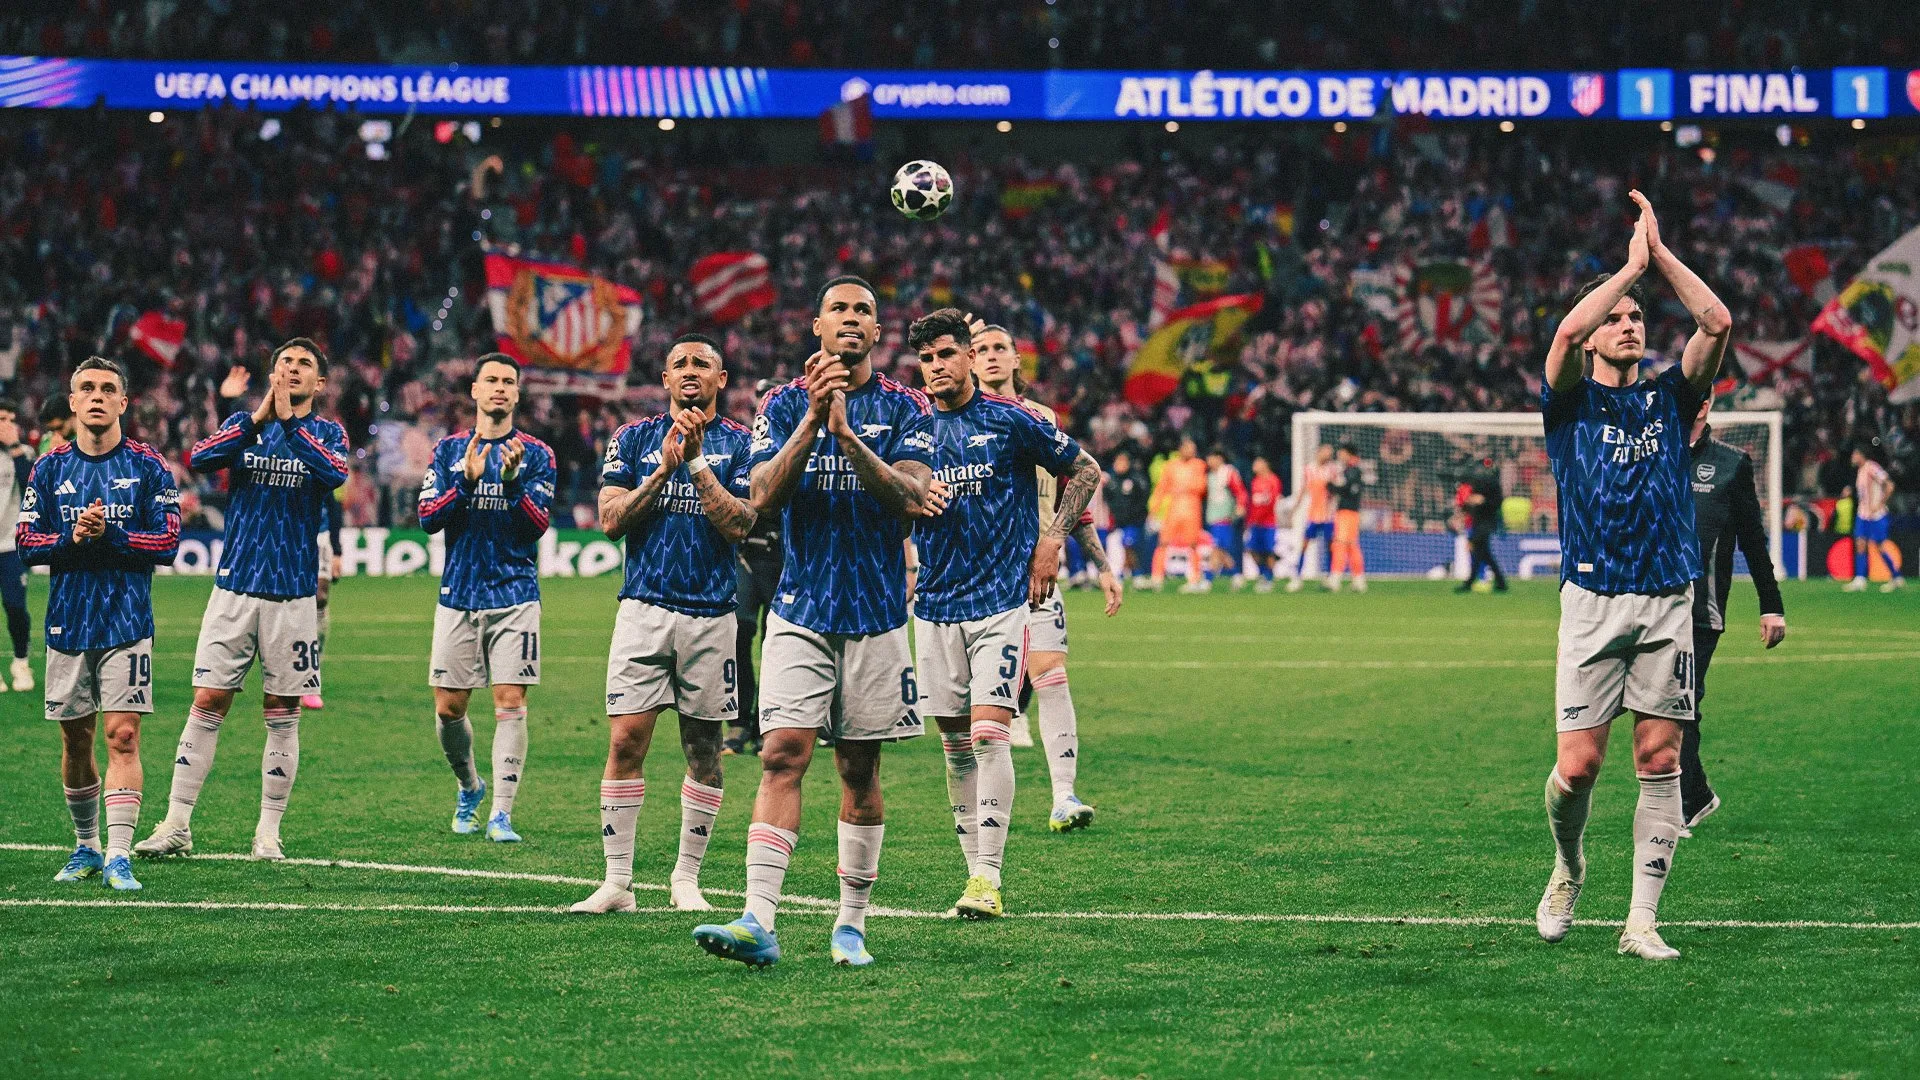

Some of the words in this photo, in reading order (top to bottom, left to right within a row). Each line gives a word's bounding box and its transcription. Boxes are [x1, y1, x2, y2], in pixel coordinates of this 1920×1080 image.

[155, 72, 227, 99] UEFA
[230, 73, 398, 102] CHAMPIONS
[1114, 69, 1312, 117] ATLÉTICO
[1318, 77, 1376, 117] DE
[1391, 77, 1551, 116] MADRID
[1635, 77, 1655, 115] 1
[1689, 74, 1819, 113] FINAL
[1852, 75, 1869, 112] 1
[244, 452, 311, 474] Emirate
[268, 472, 304, 488] BETTER
[932, 463, 994, 483] mirates
[60, 503, 135, 522] Emates
[341, 526, 625, 578] Heike
[292, 640, 320, 672] 36
[520, 632, 537, 661] 11
[998, 644, 1019, 680] 5
[127, 653, 151, 687] 19
[723, 658, 736, 694] 9
[900, 666, 918, 705] 6
[1673, 650, 1694, 690] 41
[981, 798, 998, 806] AFC
[1650, 836, 1675, 849] AFC
